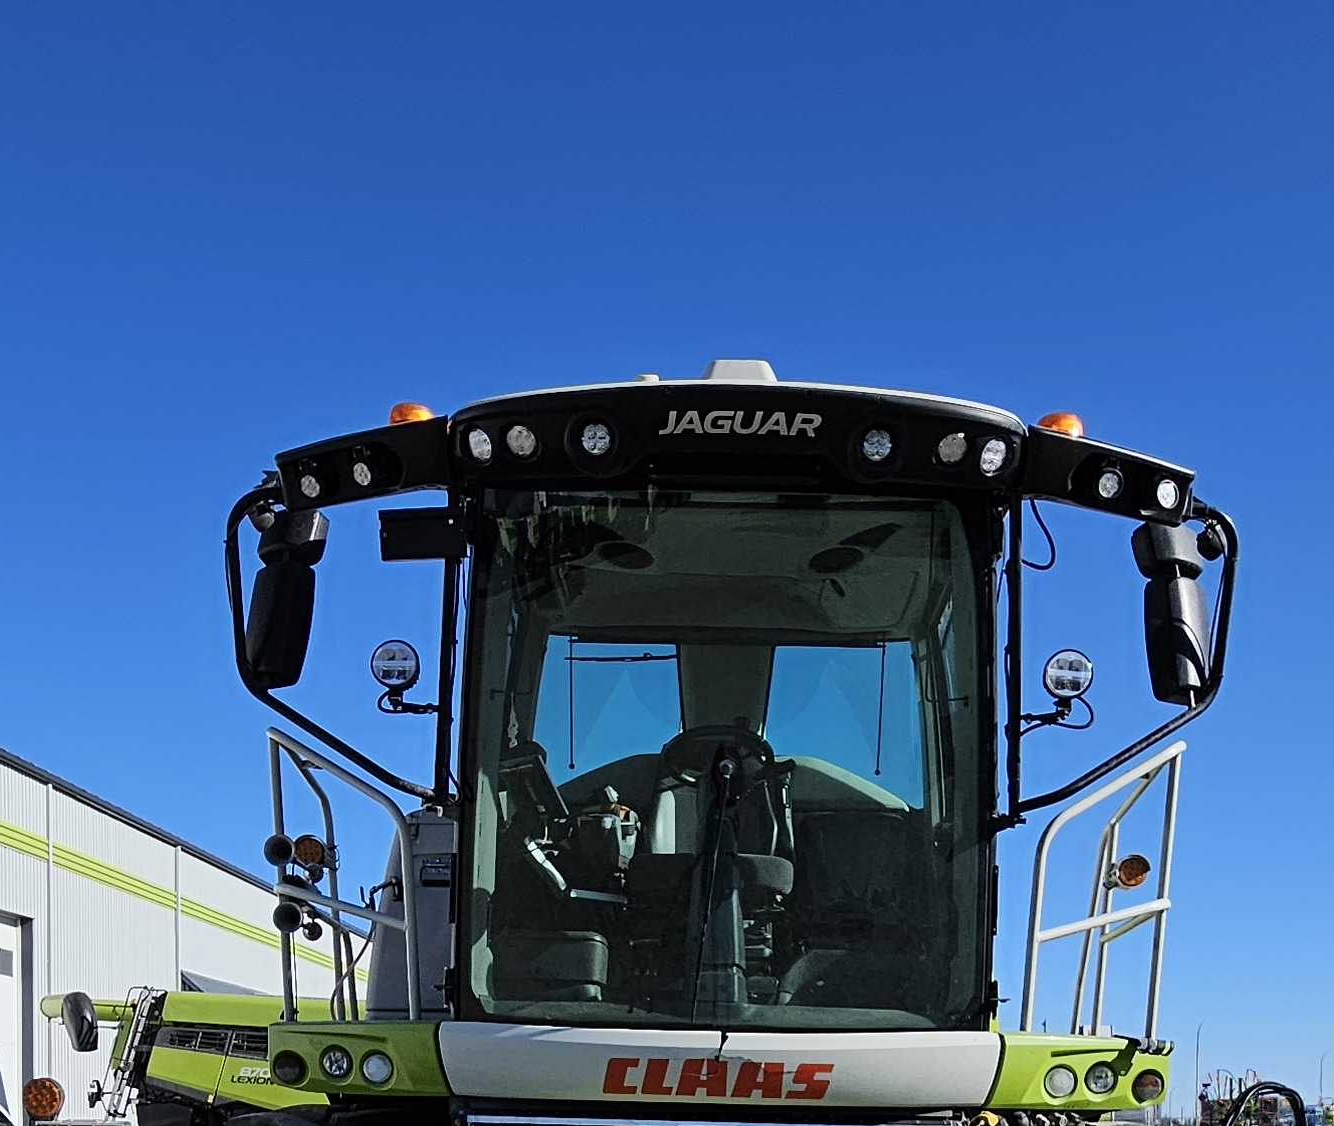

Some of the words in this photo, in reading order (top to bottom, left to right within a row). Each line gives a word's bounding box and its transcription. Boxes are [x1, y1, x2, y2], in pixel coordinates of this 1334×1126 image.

[658, 410, 823, 437] JAGUAR
[239, 1066, 271, 1077] 870
[602, 1057, 835, 1100] CLAAS
